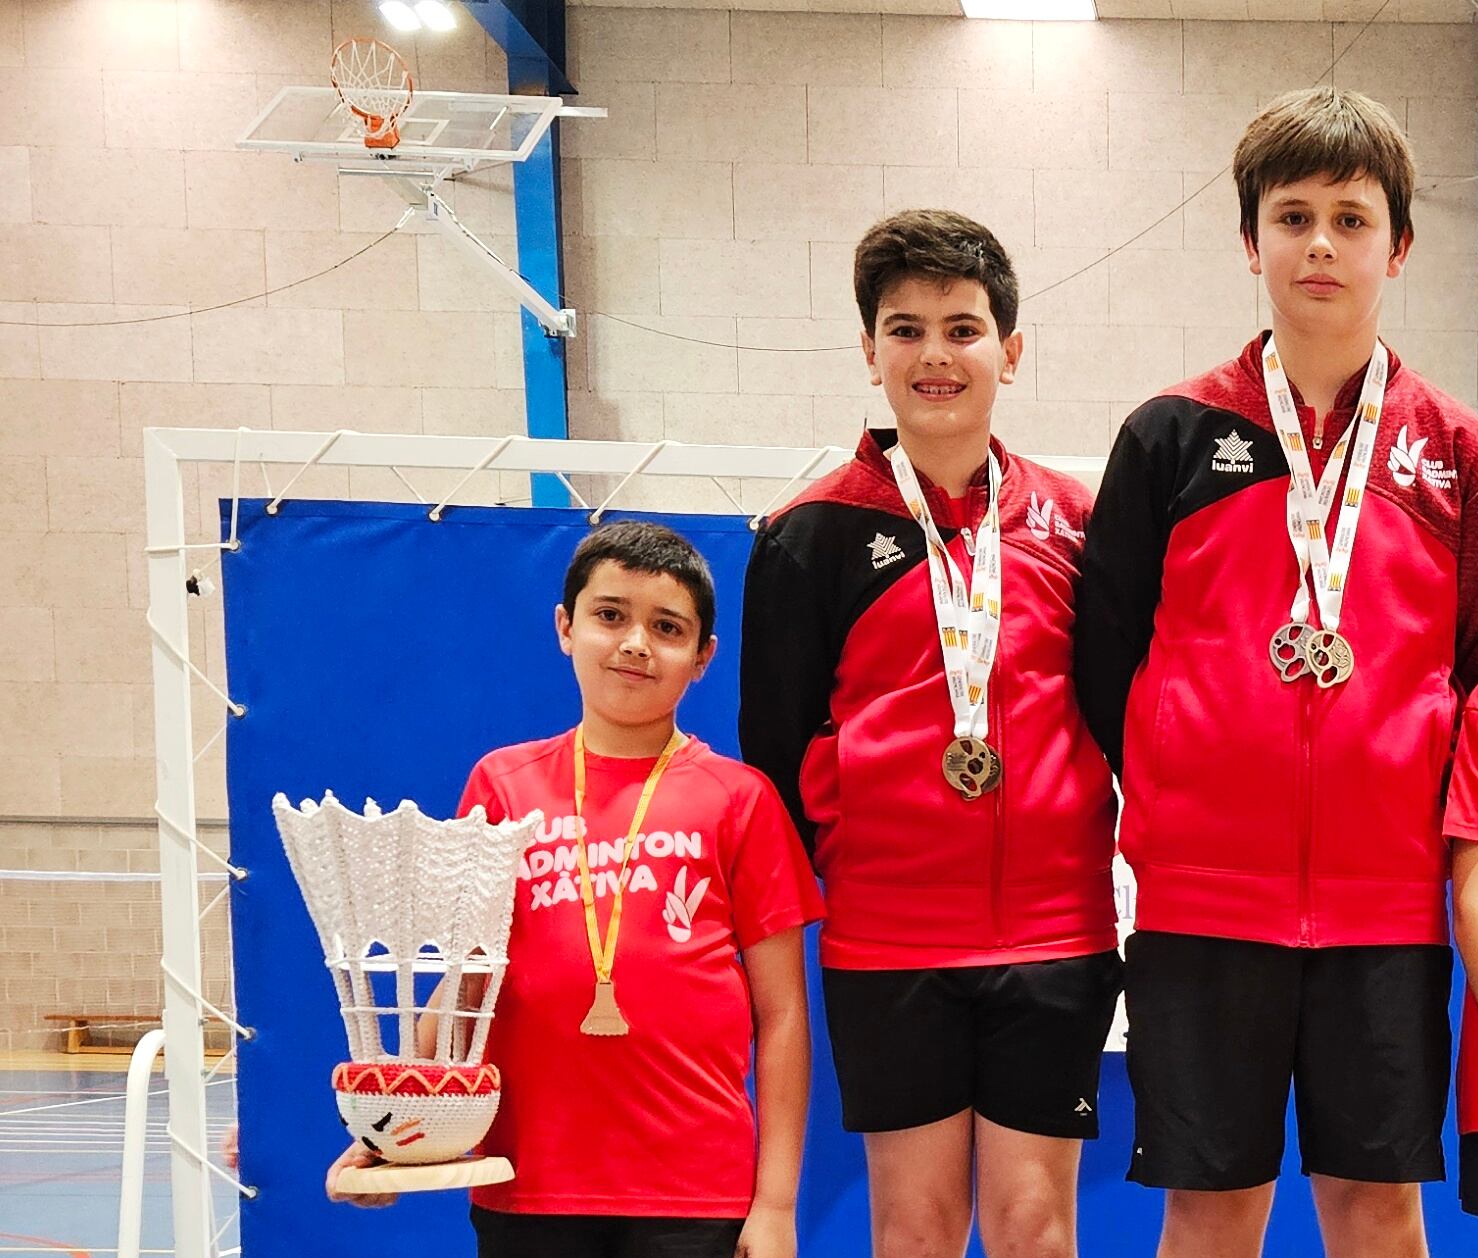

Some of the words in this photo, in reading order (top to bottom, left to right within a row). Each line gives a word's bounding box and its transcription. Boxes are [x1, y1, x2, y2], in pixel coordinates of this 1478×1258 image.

[1212, 459, 1254, 474] luanvi
[526, 815, 588, 847] UB
[516, 831, 702, 881] ADMINTON
